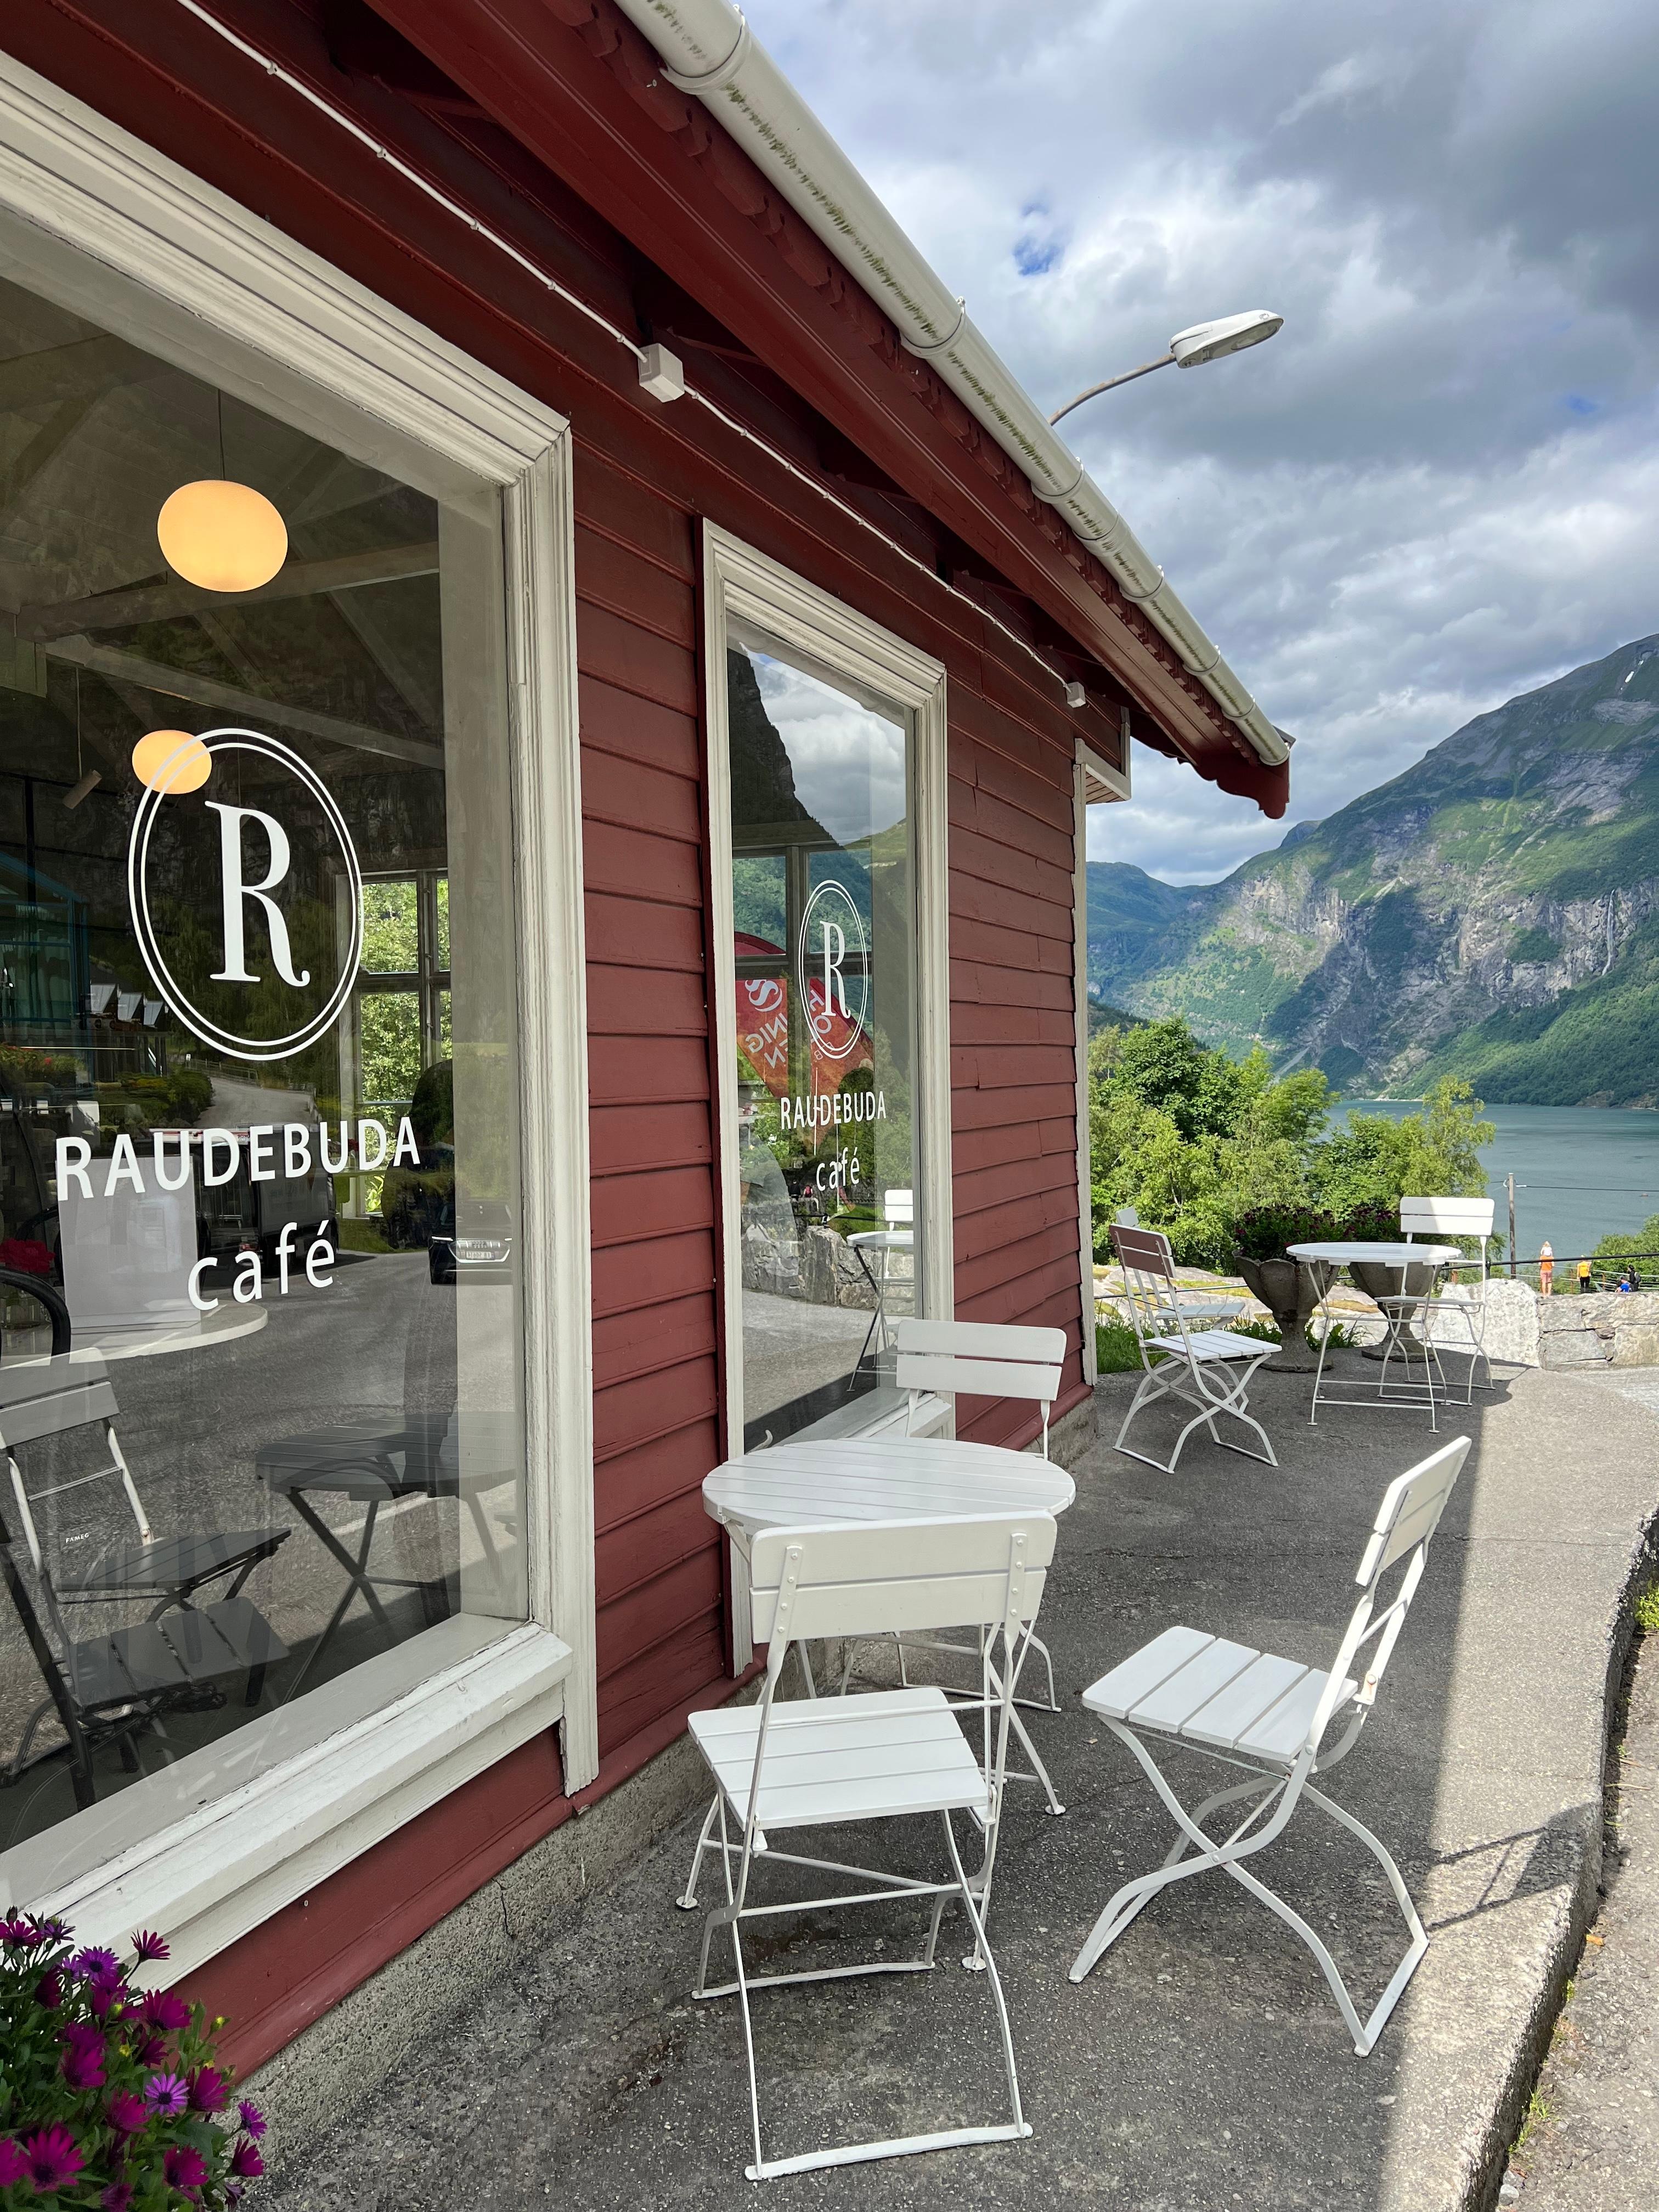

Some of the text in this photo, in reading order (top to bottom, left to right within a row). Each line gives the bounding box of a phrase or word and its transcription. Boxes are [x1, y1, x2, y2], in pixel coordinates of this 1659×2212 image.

[205, 801, 309, 986] R
[820, 921, 850, 1018] R
[781, 1091, 886, 1129] RAUDEBUDA
[57, 1117, 420, 1201] RAUDEBUDA
[817, 1147, 859, 1190] café
[188, 1221, 334, 1310] café
[65, 1532, 89, 1543] FAMEG
